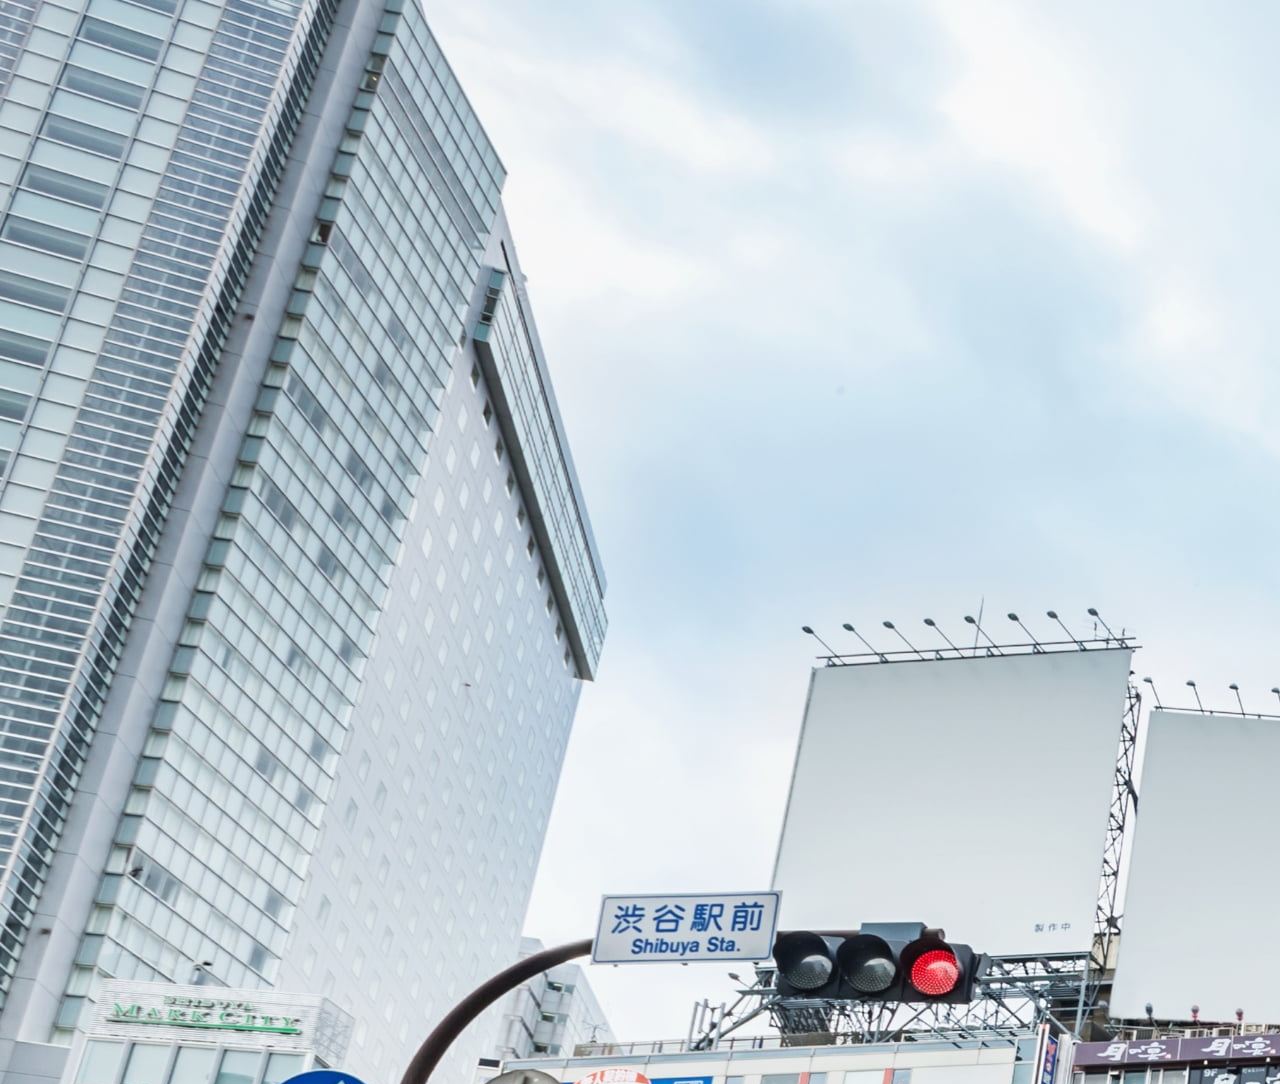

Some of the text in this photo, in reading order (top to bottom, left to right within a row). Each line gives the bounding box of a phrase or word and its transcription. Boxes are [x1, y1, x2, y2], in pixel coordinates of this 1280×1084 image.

[611, 902, 765, 934] 渋谷駅前
[631, 937, 741, 956] Shibuya Sta.
